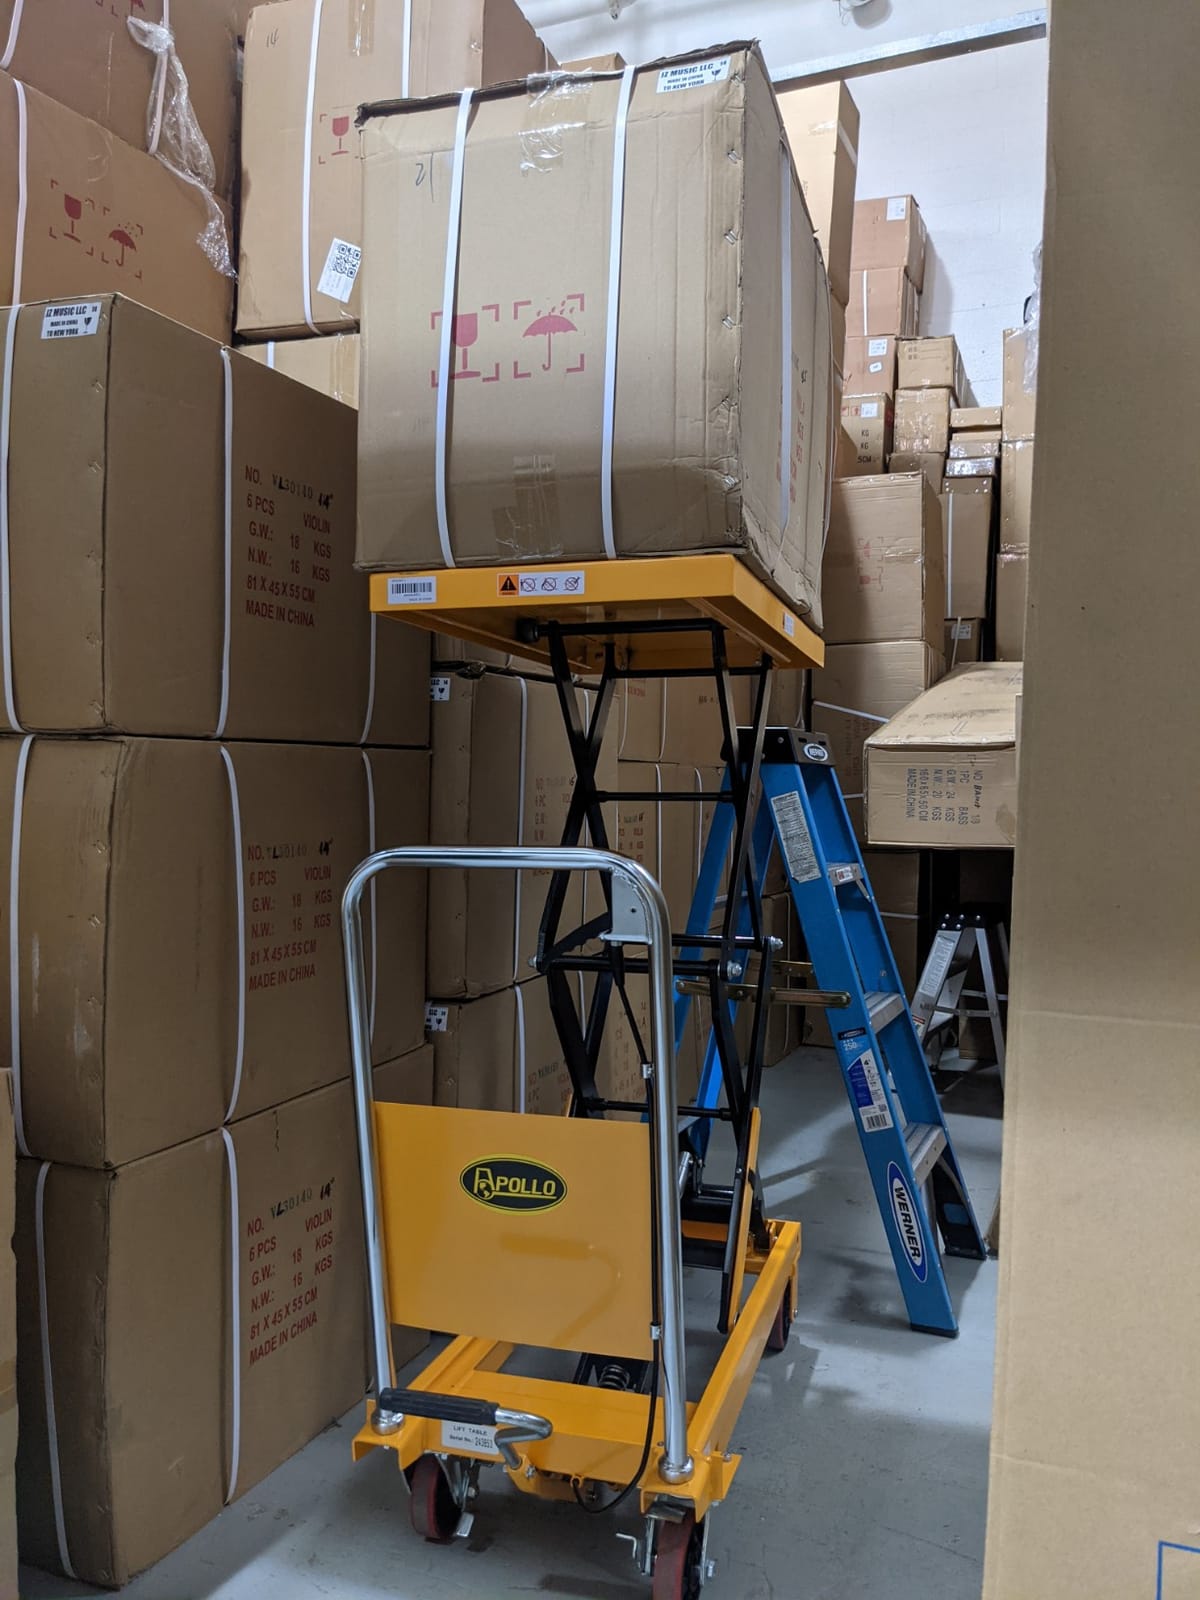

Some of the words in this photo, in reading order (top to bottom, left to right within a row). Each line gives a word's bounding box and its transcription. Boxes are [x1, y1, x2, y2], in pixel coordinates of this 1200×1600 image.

[670, 67, 698, 76] MUSIC
[53, 307, 75, 317] MUSIC
[76, 306, 87, 315] LLC
[255, 495, 275, 516] PCS
[303, 512, 331, 534] VIOLIN
[313, 540, 331, 559] KGS
[290, 559, 300, 574] 16
[312, 564, 330, 583] KGS
[268, 581, 280, 596] 45
[289, 583, 300, 600] 55
[302, 587, 316, 603] CM
[246, 599, 275, 619] MADE
[276, 606, 286, 621] IN
[287, 608, 315, 627] CHINA
[931, 806, 942, 821] KGS
[944, 807, 955, 822] KGS
[958, 806, 969, 825] BASS
[257, 870, 277, 886] PCS
[303, 864, 332, 881] VIOLIN
[315, 889, 332, 905] KGS
[292, 917, 303, 933] 16
[314, 913, 332, 929] KGS
[271, 947, 282, 962] 45
[291, 942, 302, 957] 55
[303, 939, 317, 955] CM
[248, 972, 277, 993] MADE
[277, 969, 288, 985] IN
[289, 963, 316, 983] CHINA
[473, 1167, 557, 1200] APOLLO
[257, 1236, 277, 1258] PCS
[304, 1208, 333, 1233] VIOLIN
[895, 1186, 921, 1259] WERNER
[315, 1230, 334, 1252] KGS
[293, 1271, 304, 1289] 16
[314, 1254, 333, 1276] KGS
[271, 1308, 284, 1327] 45
[292, 1295, 304, 1313] 55
[304, 1285, 319, 1306] CM
[249, 1335, 278, 1367] MADE
[279, 1328, 289, 1347] IN
[290, 1310, 319, 1340] CHINA
[469, 1428, 488, 1436] TABLE
